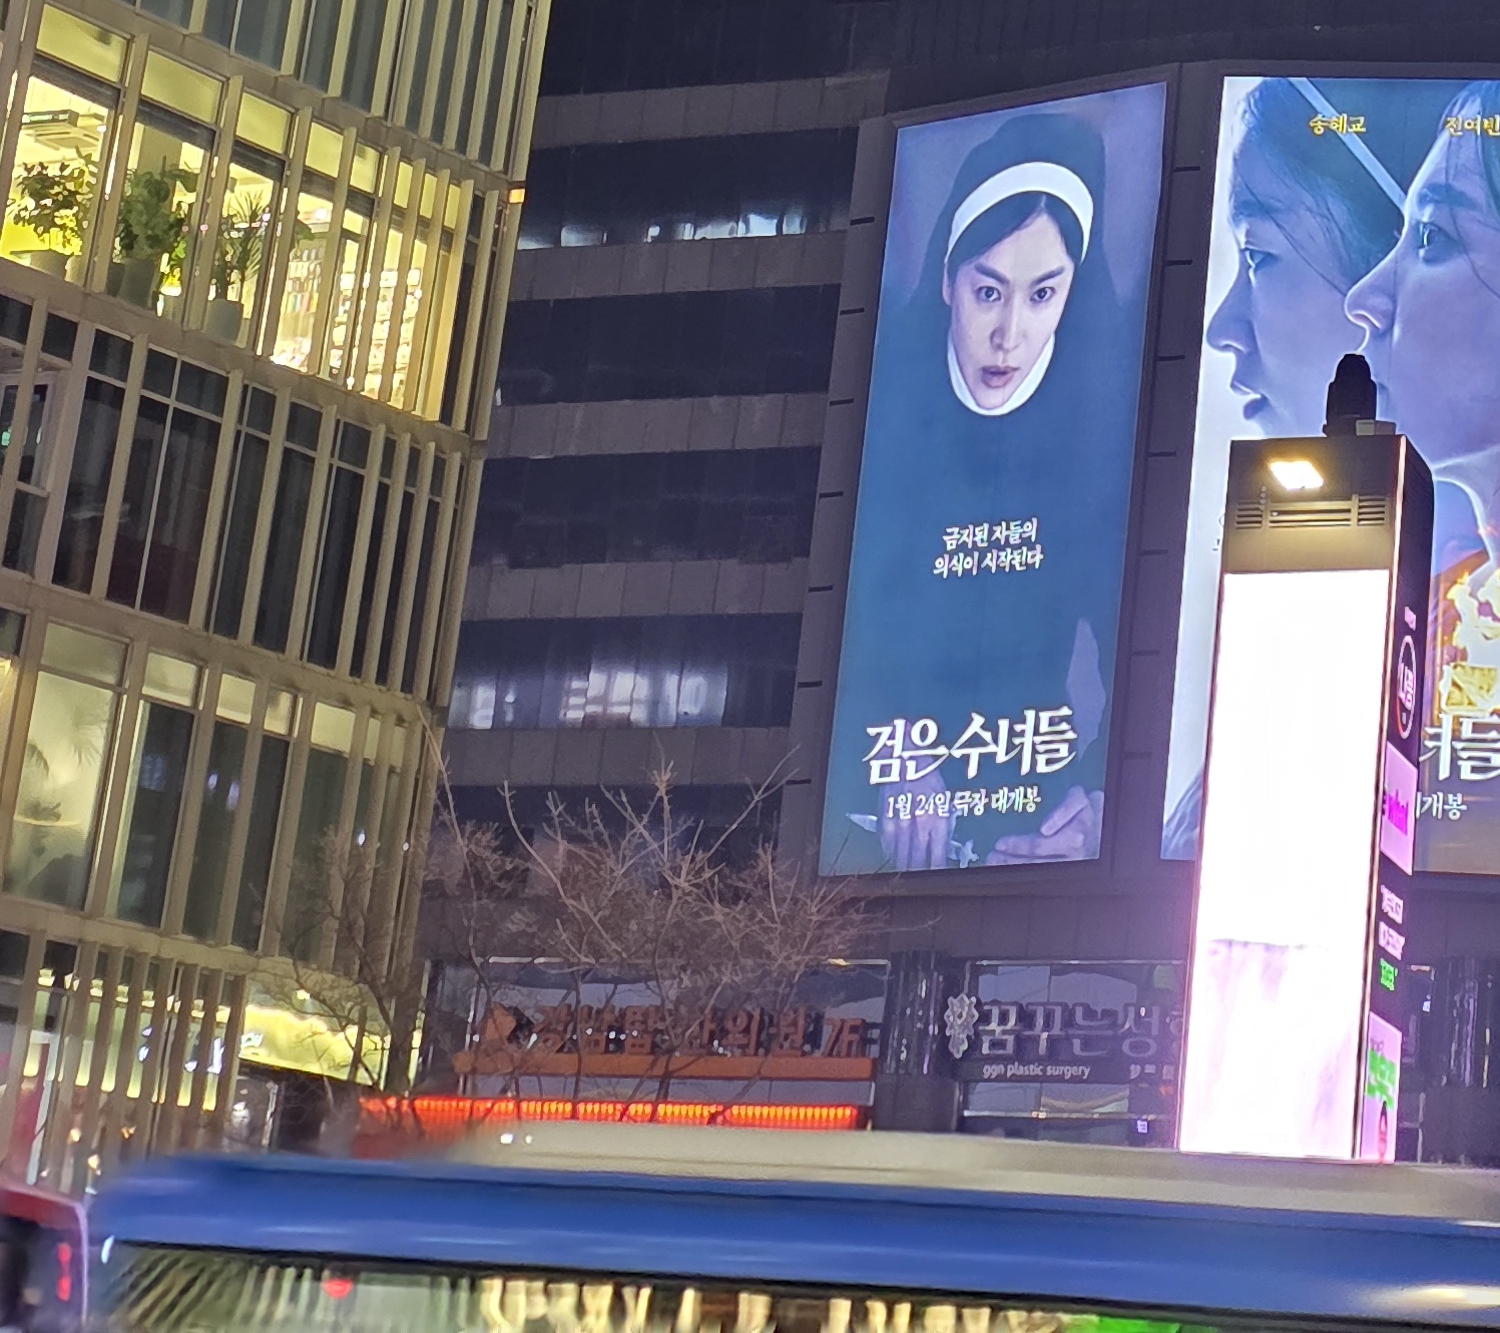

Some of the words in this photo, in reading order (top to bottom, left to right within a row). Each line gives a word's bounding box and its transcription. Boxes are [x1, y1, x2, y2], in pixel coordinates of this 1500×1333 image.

[1308, 113, 1367, 136] 송혜교
[943, 523, 989, 551] 금지된
[991, 517, 1038, 545] 자들의
[933, 551, 979, 579] 의식이
[981, 544, 1044, 573] 시작된다
[887, 793, 912, 819] 1월
[915, 790, 950, 817] 24일
[952, 788, 989, 817] 극장
[991, 786, 1042, 814] 대개봉
[1414, 791, 1468, 821] 개봉
[822, 1017, 865, 1057] 7F
[1006, 1062, 1043, 1079] plastic
[1046, 1063, 1091, 1080] surgery
